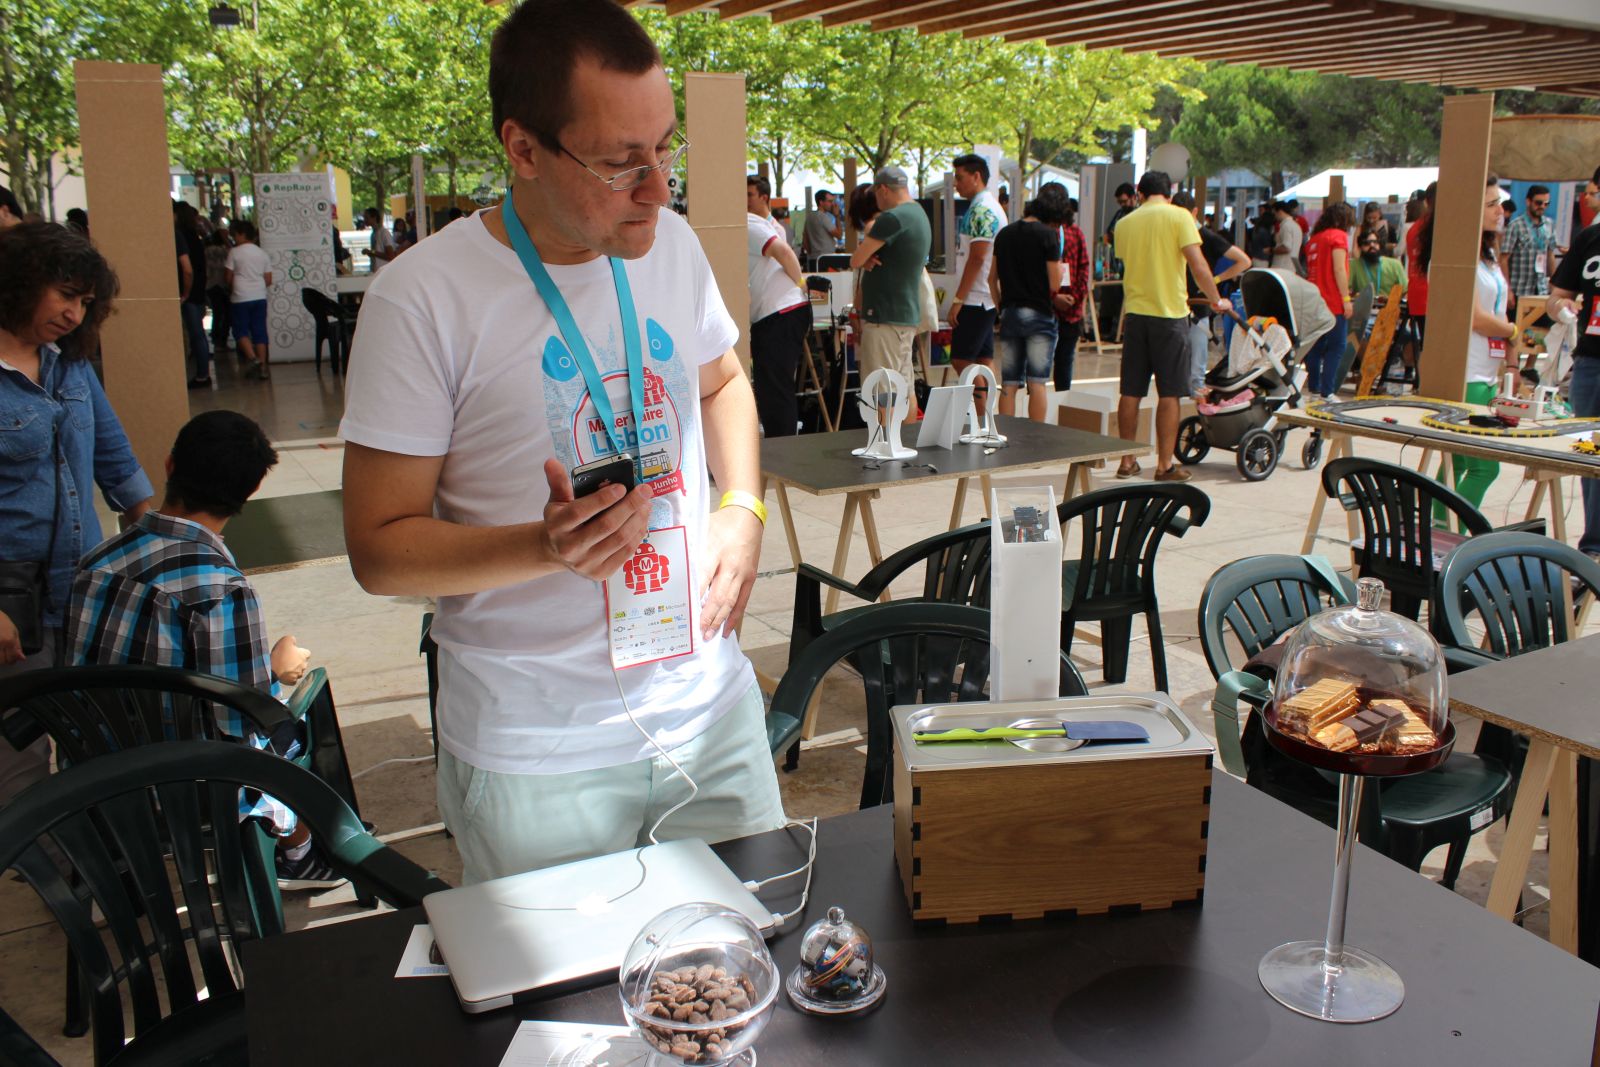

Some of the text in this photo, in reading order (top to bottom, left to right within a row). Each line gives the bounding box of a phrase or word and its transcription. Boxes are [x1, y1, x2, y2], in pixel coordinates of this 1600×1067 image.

[588, 416, 628, 433] Mer
[591, 423, 669, 455] Lisbon
[653, 476, 678, 490] Junho
[641, 558, 652, 570] M
